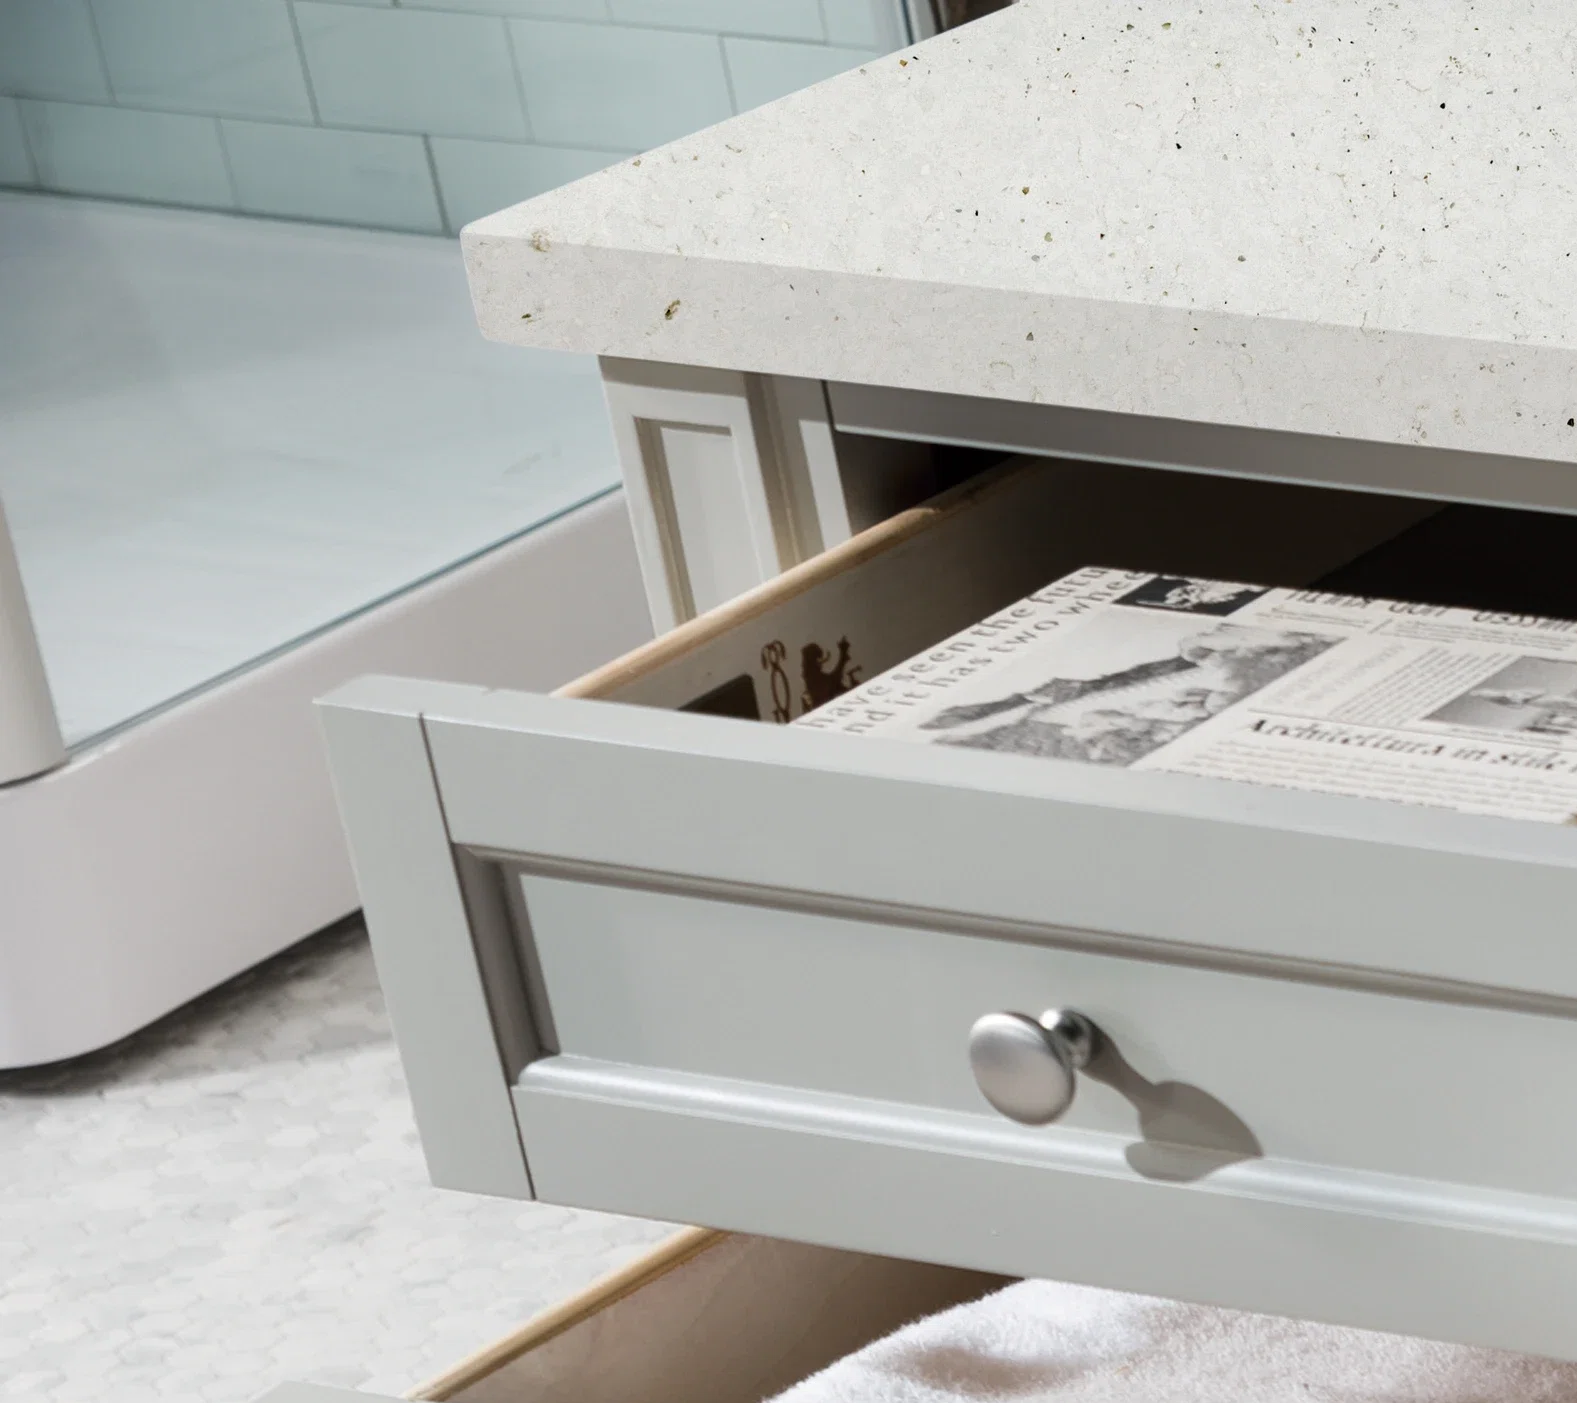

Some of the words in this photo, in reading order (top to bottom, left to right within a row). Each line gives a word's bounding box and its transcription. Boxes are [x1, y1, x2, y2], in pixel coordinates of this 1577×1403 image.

[797, 686, 892, 728] have
[891, 640, 976, 682] seen
[972, 607, 1036, 637] the
[884, 692, 930, 706] it
[918, 656, 993, 688] has
[988, 620, 1060, 652] two
